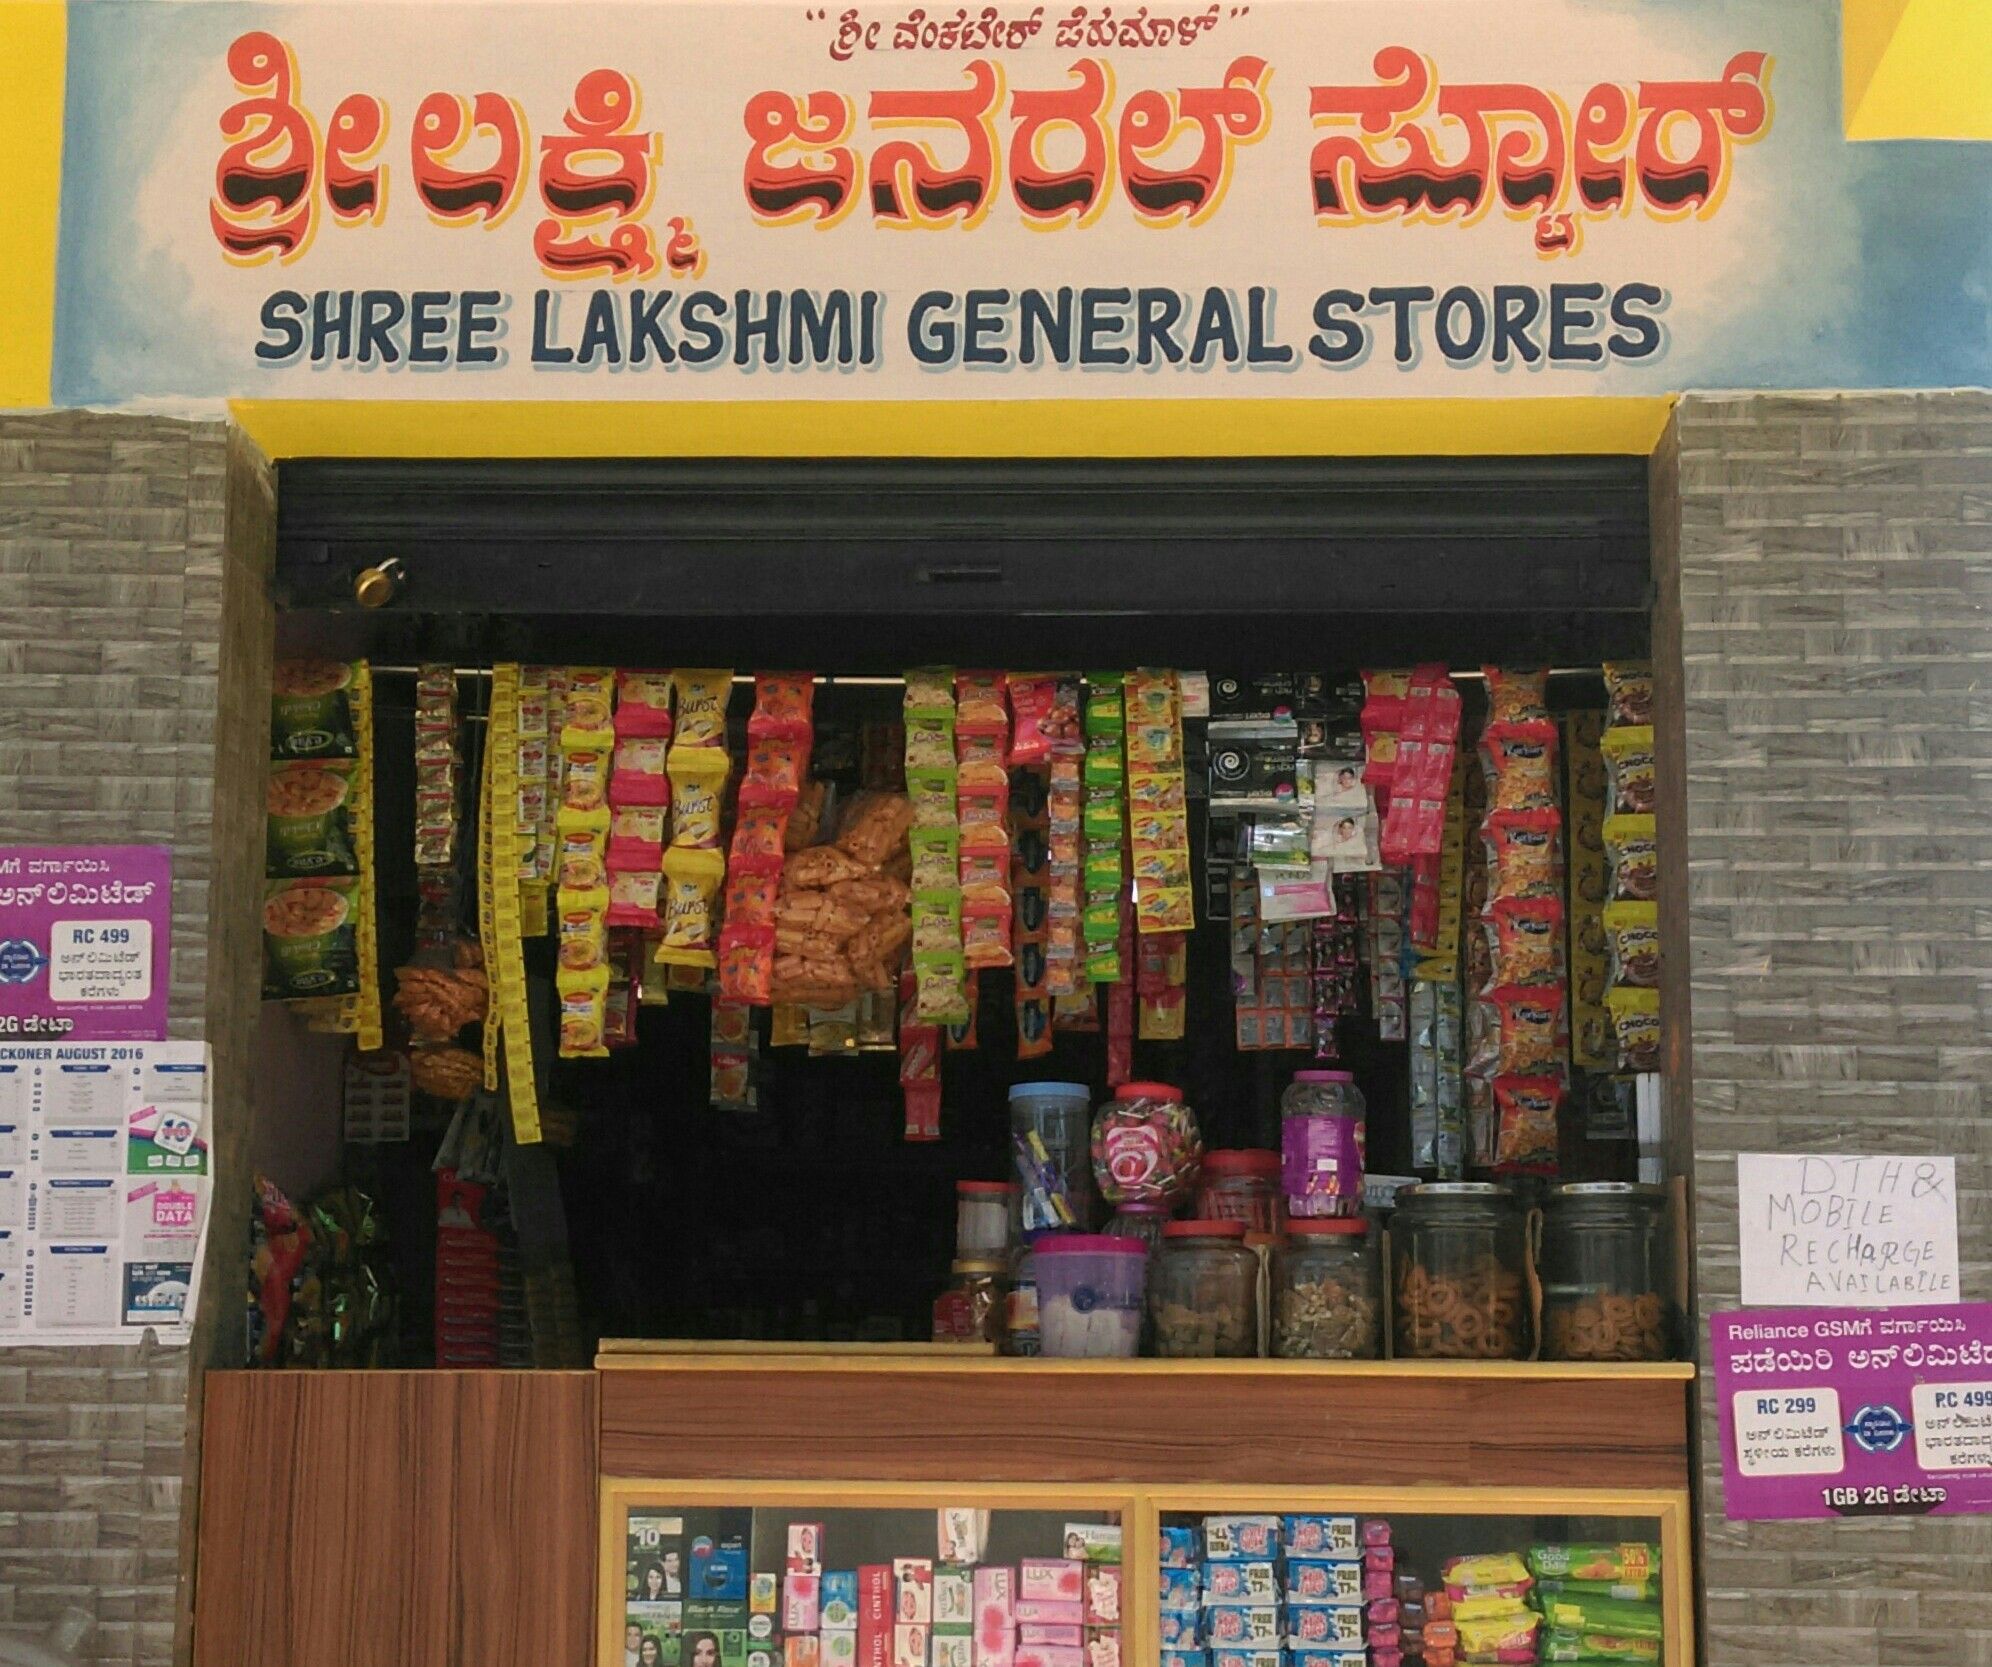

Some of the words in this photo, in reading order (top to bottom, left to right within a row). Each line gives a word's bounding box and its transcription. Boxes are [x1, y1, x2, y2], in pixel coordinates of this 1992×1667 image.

[742, 57, 1270, 226] ಜನರಲ್
[1308, 47, 1770, 254] ಸ್ಟೋರ್
[255, 290, 505, 368] SHREE
[530, 289, 882, 368] LAKSHMI
[908, 286, 1296, 367] GENERAL
[1308, 283, 1666, 365] STORES
[73, 929, 94, 944] RC
[100, 929, 130, 943] 499
[56, 1048, 107, 1060] AUGUST
[111, 1047, 144, 1060] 2016
[1767, 1193, 1893, 1231] MOBILE
[1728, 1323, 1809, 1340] Reliance
[1757, 1398, 1780, 1414] RC
[1785, 1397, 1816, 1413] 299
[1963, 1390, 1992, 1406] 499
[1822, 1486, 1860, 1505] 1GB
[1864, 1486, 1889, 1504] 2G
[635, 1527, 660, 1546] 10
[1026, 1568, 1054, 1581] LUX
[994, 1572, 1007, 1600] LUX
